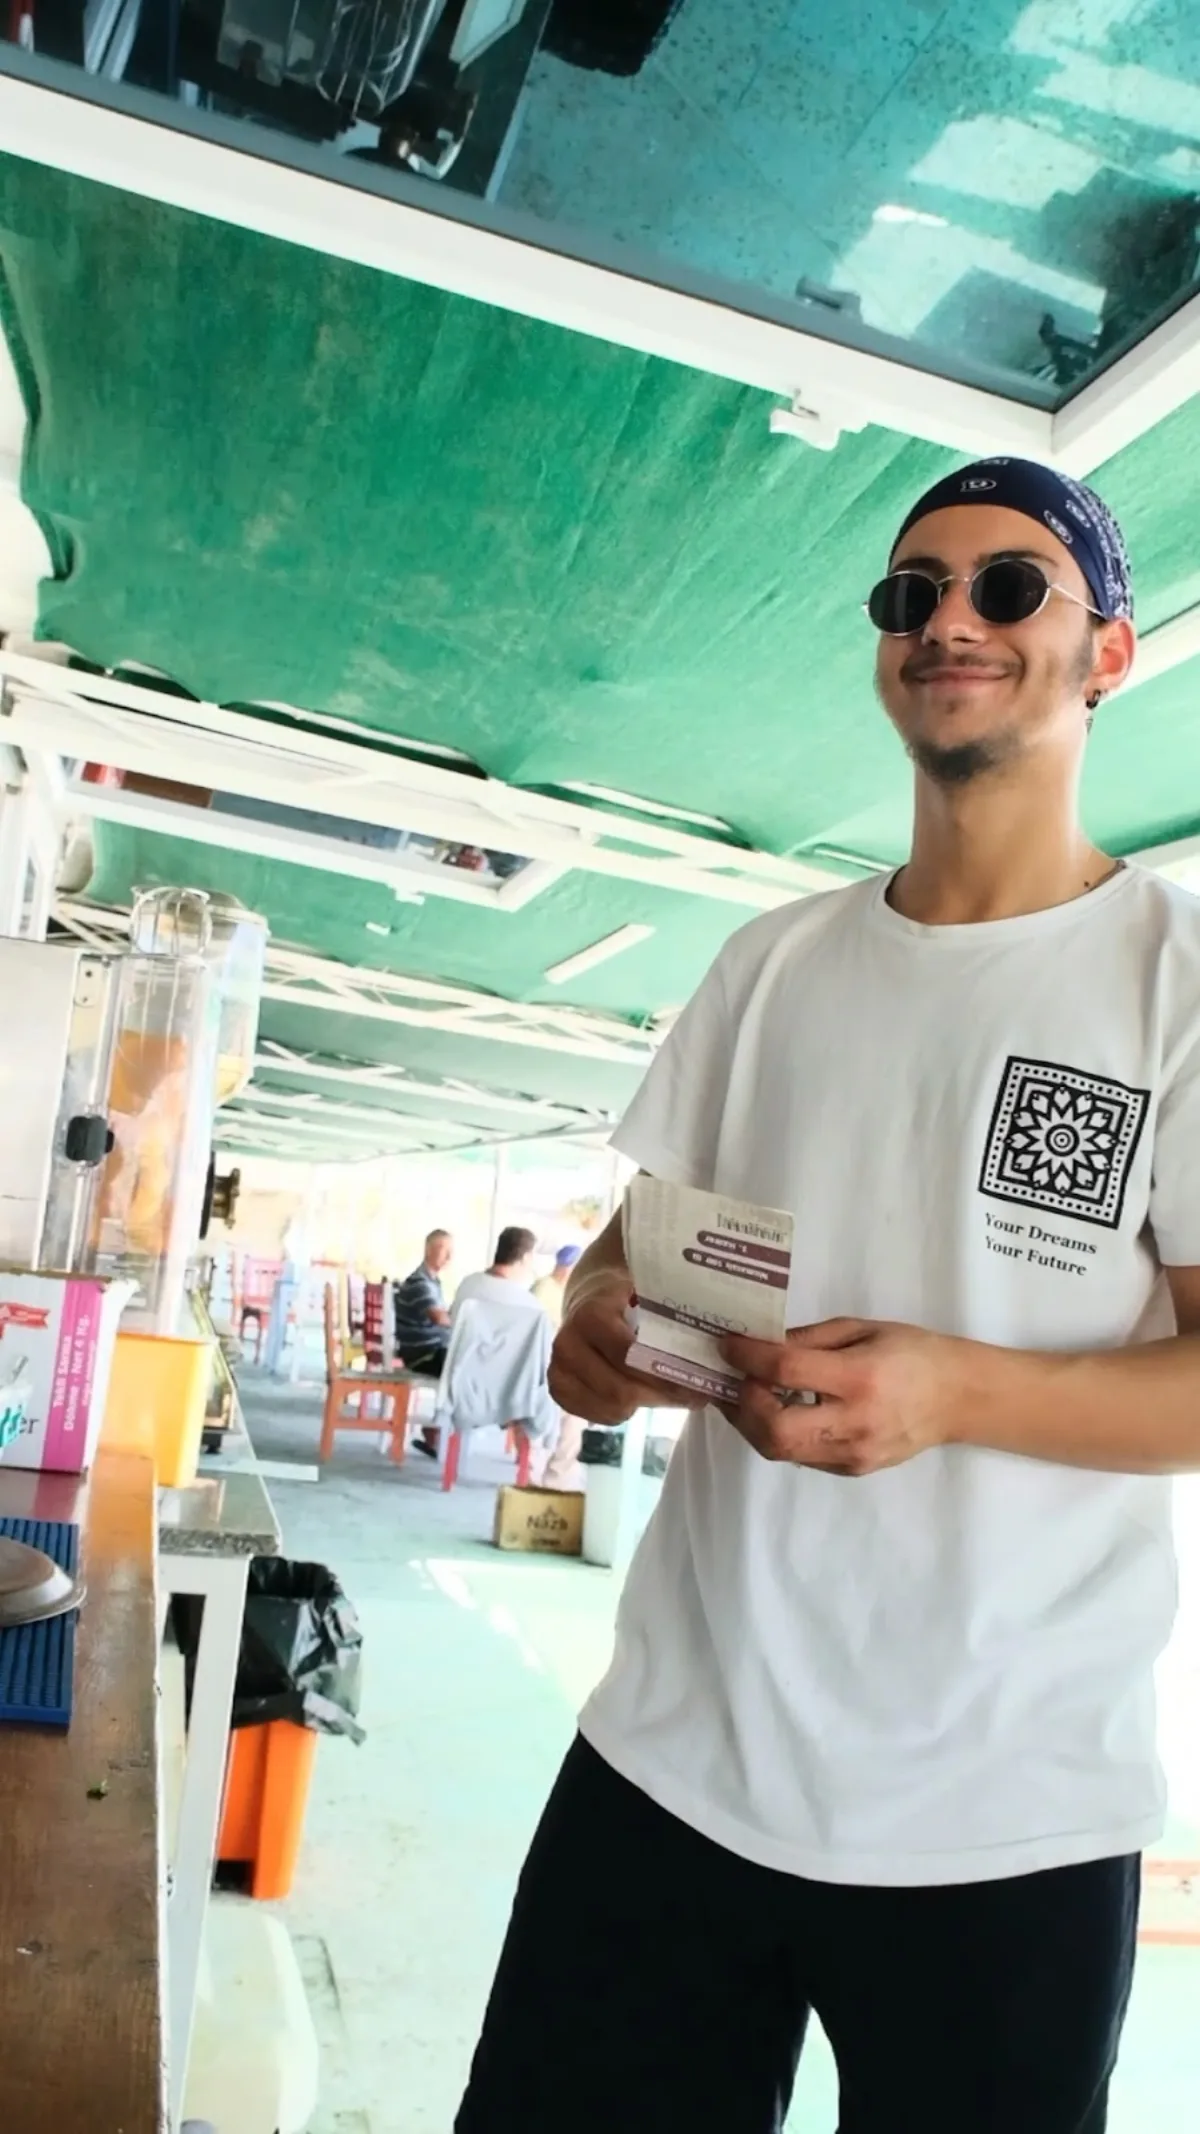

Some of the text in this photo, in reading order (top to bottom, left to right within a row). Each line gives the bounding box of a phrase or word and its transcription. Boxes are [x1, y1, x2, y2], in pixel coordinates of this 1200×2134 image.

[985, 1212, 1097, 1254] Your Dreams
[985, 1235, 1087, 1276] Your Future
